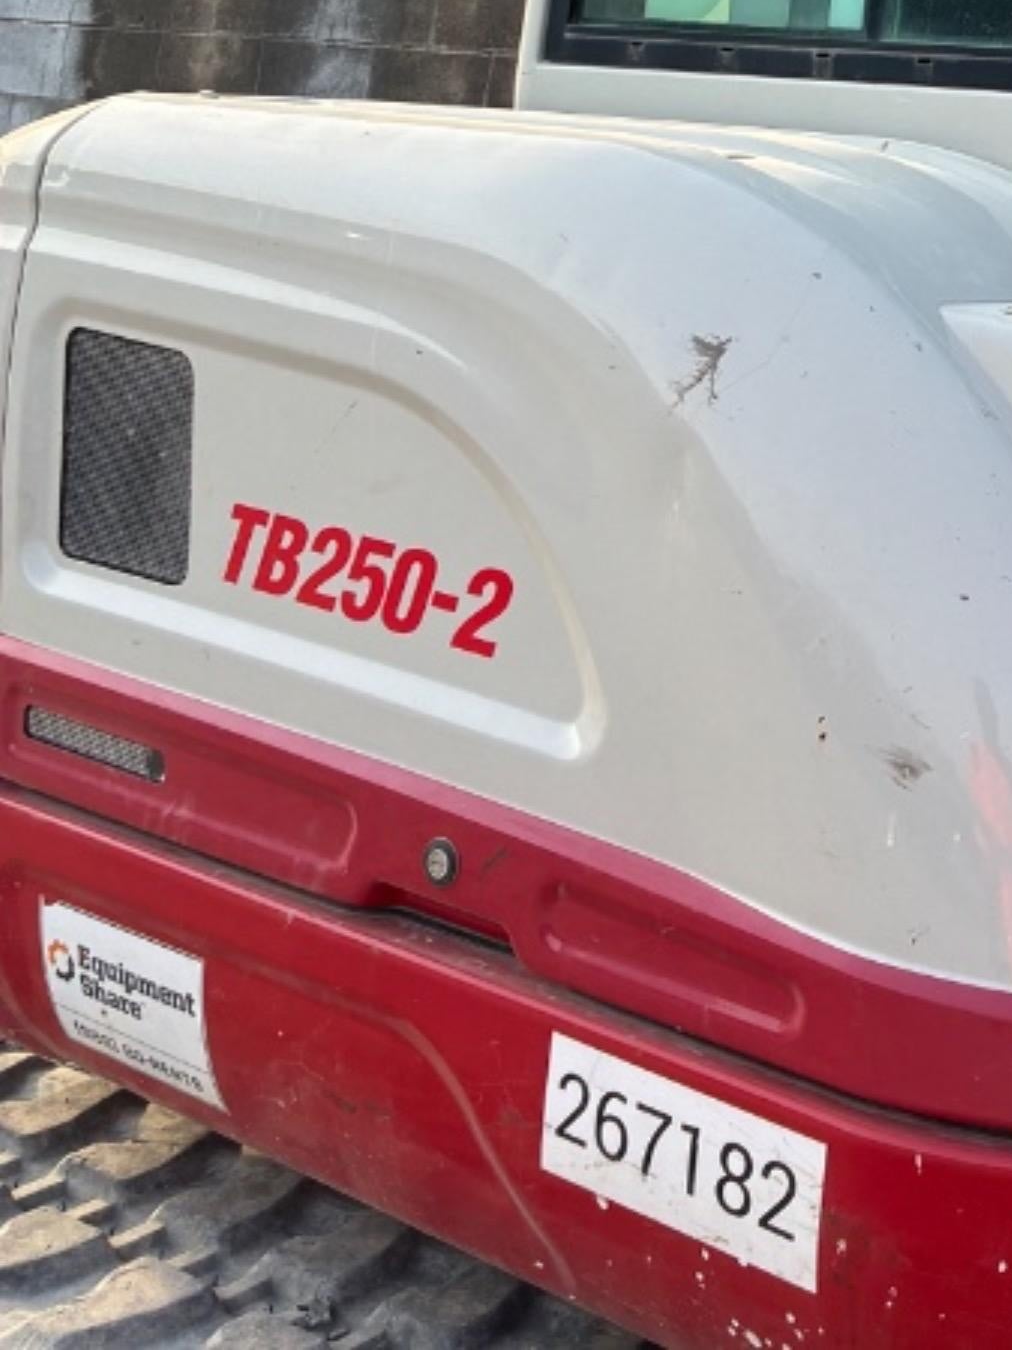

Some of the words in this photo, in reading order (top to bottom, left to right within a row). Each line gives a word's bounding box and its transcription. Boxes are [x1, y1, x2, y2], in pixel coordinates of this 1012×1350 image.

[222, 503, 514, 658] TB250-2
[77, 944, 196, 1018] Equipment
[80, 974, 142, 1020] Share
[555, 1072, 796, 1241] 267182
